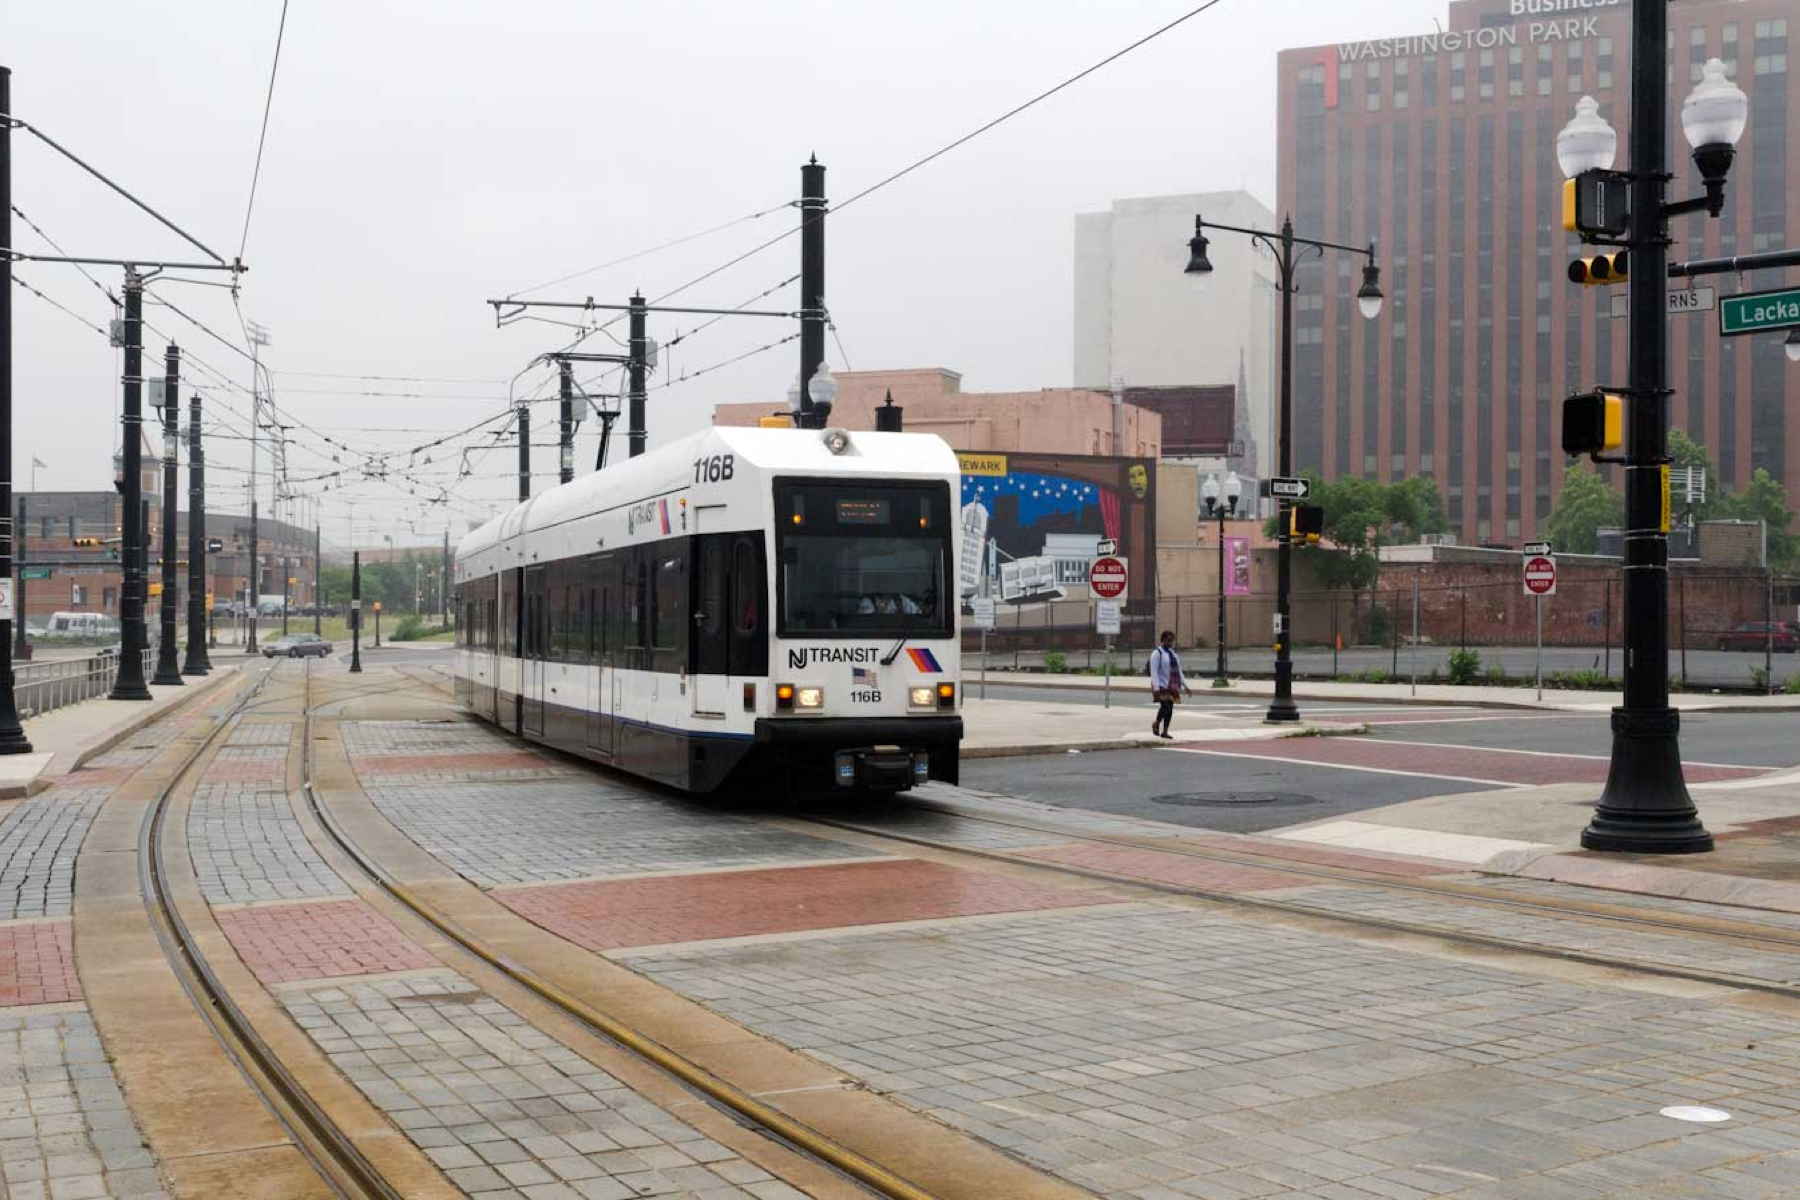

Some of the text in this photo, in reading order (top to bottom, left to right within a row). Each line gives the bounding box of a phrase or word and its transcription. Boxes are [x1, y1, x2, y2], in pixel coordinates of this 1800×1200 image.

[1337, 26, 1516, 61] WASHINGTON
[1529, 16, 1599, 44] PARK
[1669, 293, 1698, 308] RNS
[1741, 300, 1800, 323] Lacka
[694, 454, 734, 483] 116B
[1098, 583, 1120, 591] ENTER
[809, 647, 880, 662] TRANSIT
[851, 691, 882, 703] 116B
